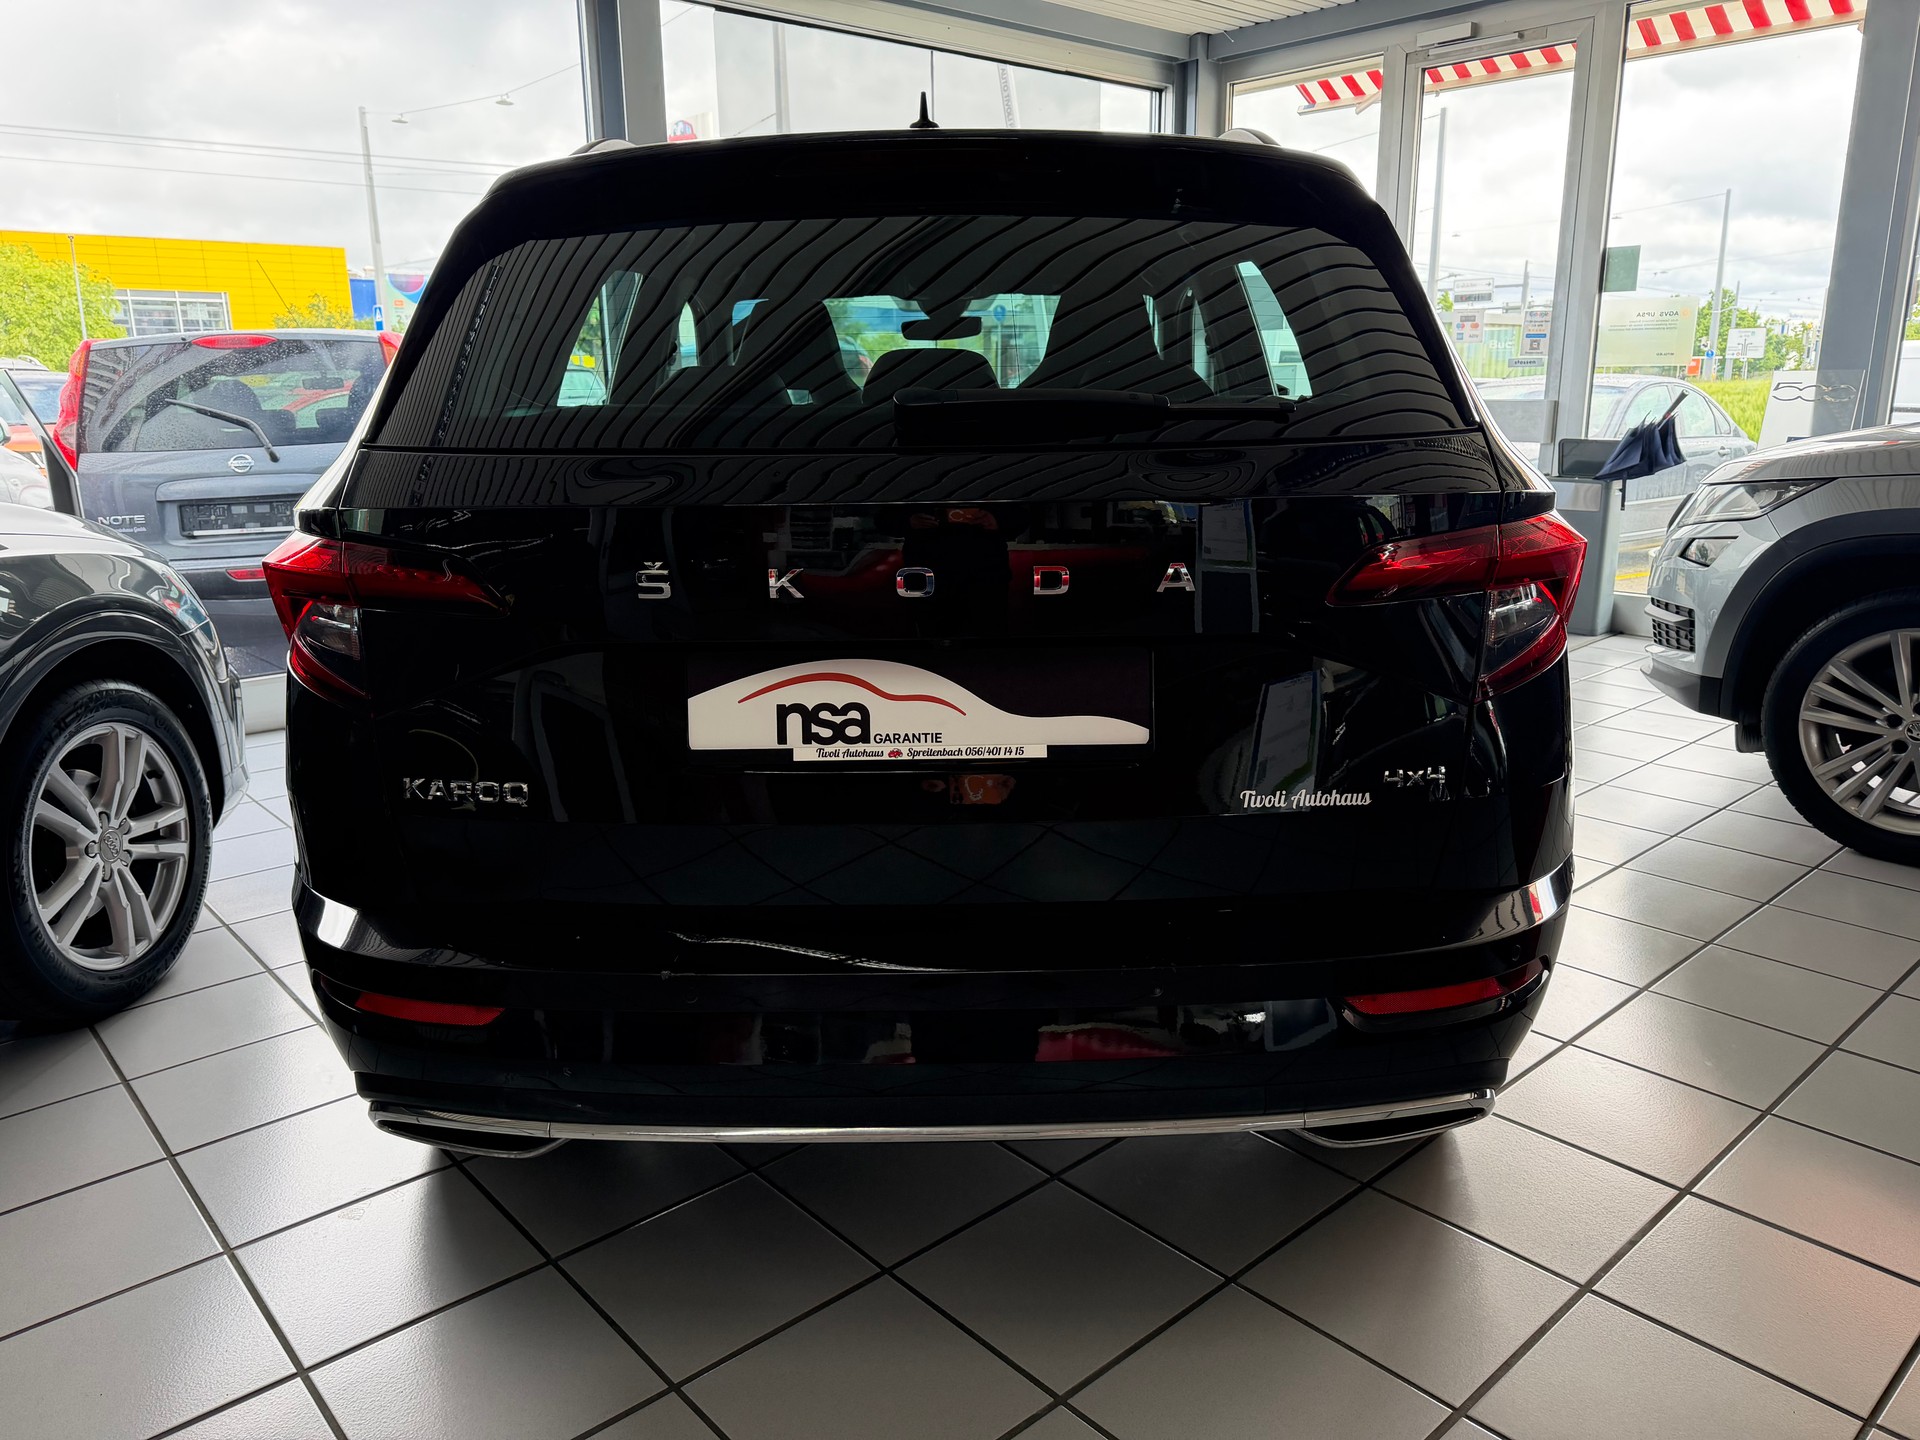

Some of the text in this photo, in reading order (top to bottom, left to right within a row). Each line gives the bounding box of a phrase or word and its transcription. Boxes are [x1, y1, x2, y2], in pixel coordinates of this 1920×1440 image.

[1772, 382, 1857, 402] 500
[97, 514, 146, 525] NOTE
[776, 702, 943, 745] nsa GARANTIE
[816, 746, 1025, 760] Tivoli Autohaus Spreitenbach 056/401 14 15
[1384, 766, 1446, 788] 4x4
[403, 777, 529, 807] KAROQ
[1240, 788, 1373, 810] Tivoli Autohaus
